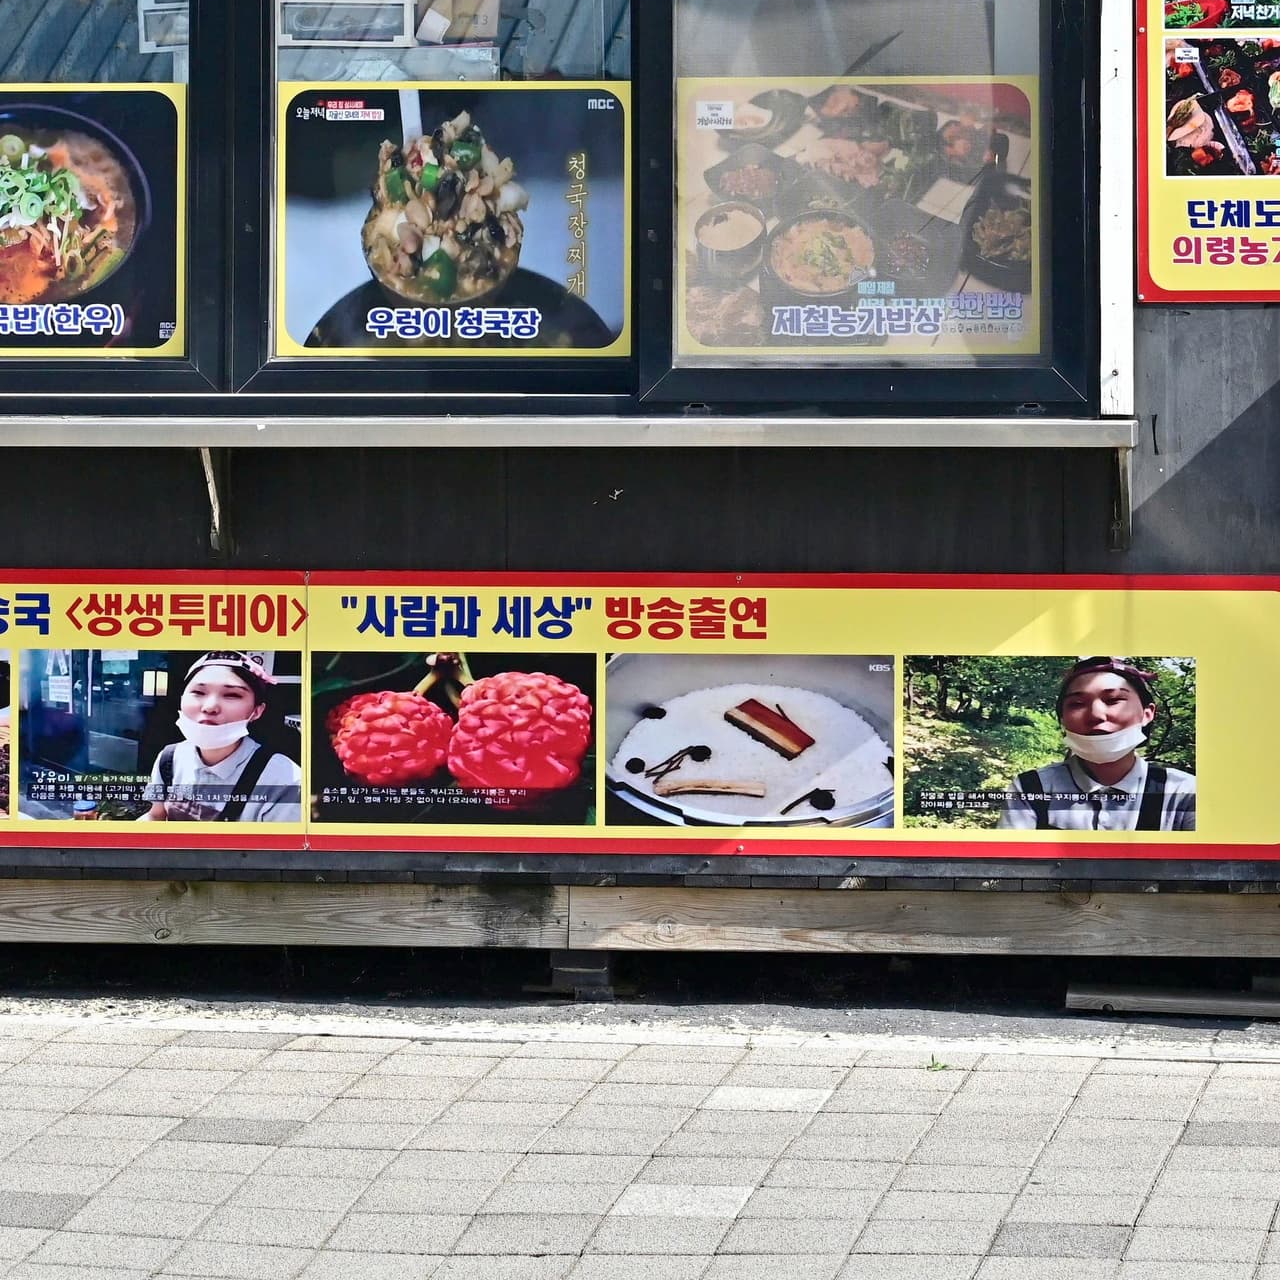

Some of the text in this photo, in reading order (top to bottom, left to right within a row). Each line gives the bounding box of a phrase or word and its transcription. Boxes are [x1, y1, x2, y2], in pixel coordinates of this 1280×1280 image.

[296, 106, 325, 120] 오늘저녁
[588, 98, 615, 110] MBC
[565, 153, 588, 297] 청국장찌개
[366, 307, 541, 338] 우렁이 청국장
[772, 305, 943, 336] 제철농가밥상
[605, 596, 768, 640] 방송출연
